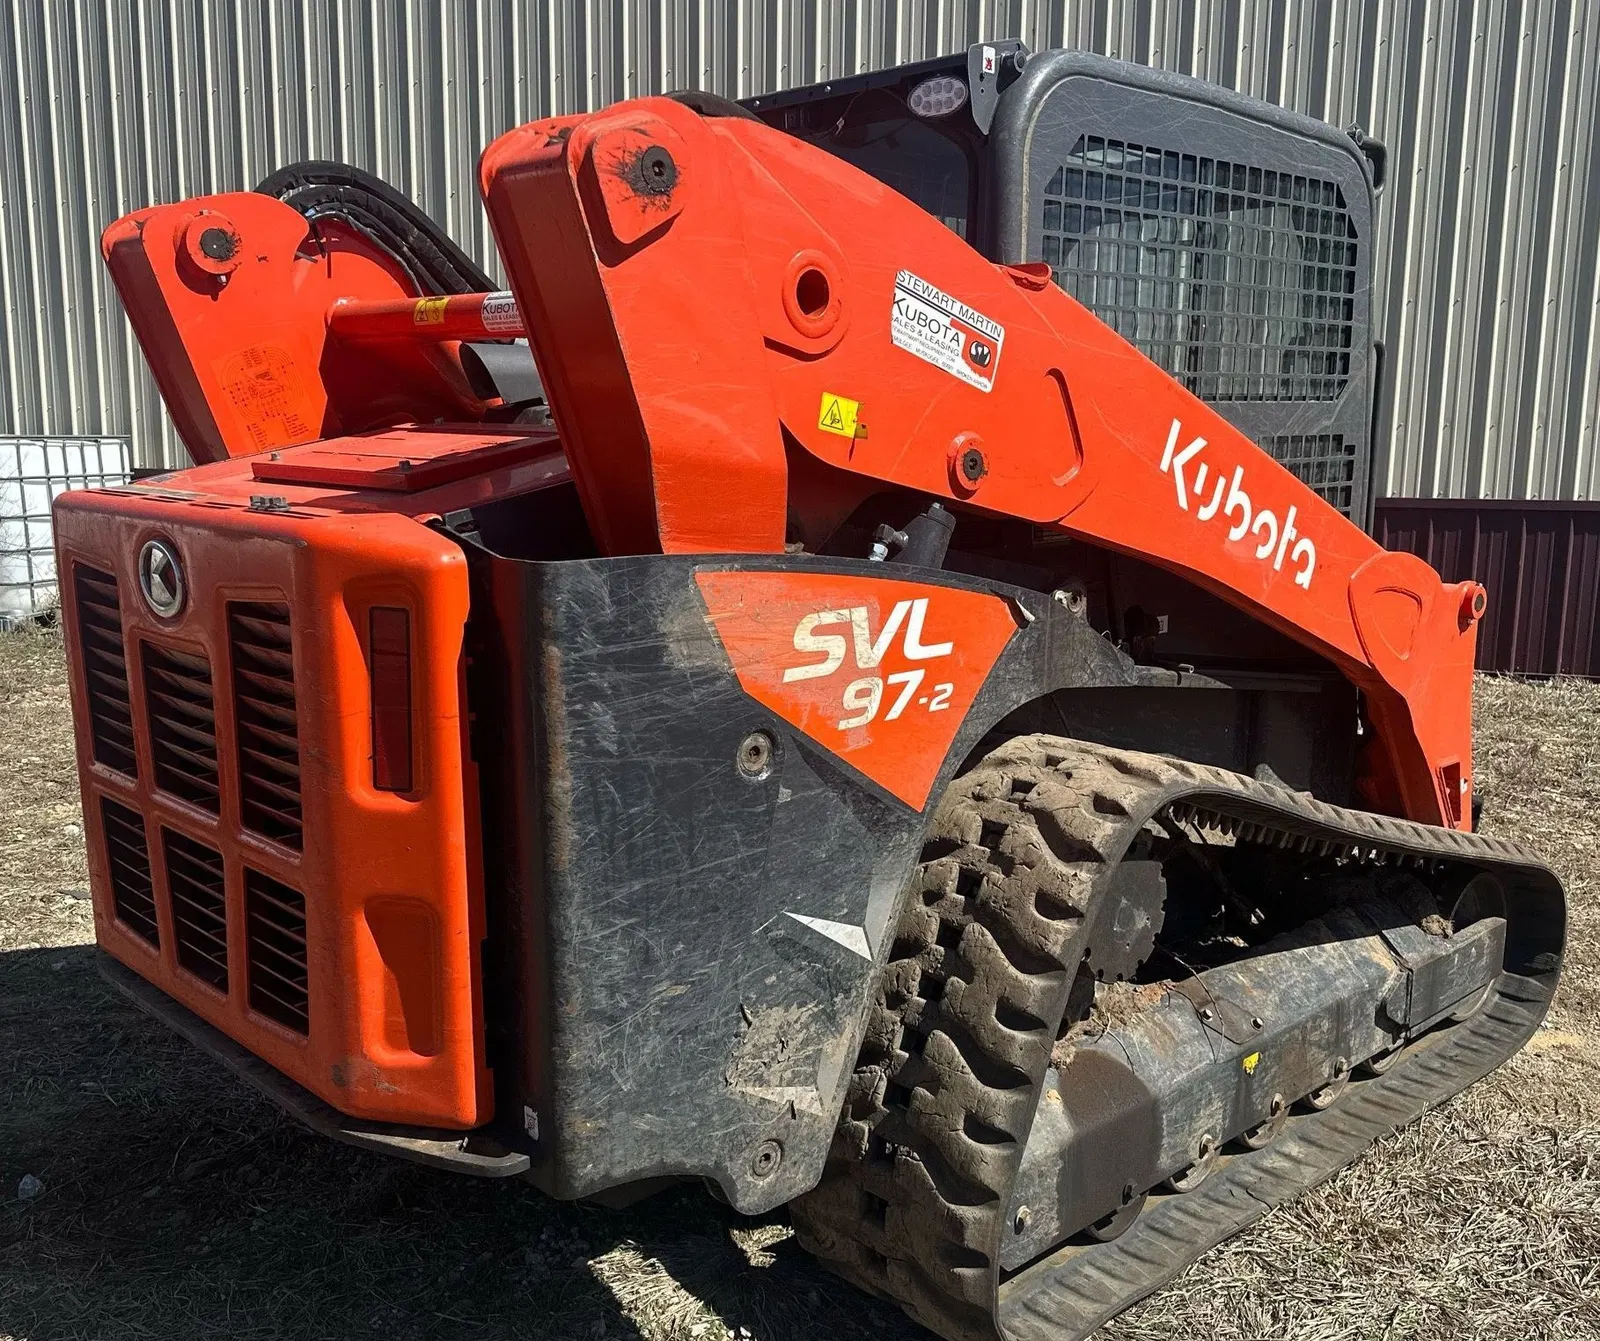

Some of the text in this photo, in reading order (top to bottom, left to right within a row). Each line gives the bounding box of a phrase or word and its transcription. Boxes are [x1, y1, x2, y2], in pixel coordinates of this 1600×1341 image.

[892, 293, 960, 347] KUBOTA
[897, 270, 1002, 338] STEWART MARTIN
[924, 333, 960, 357] LEASING
[1160, 418, 1316, 590] Kubota
[782, 598, 953, 683] SVL
[838, 668, 953, 730] 97-2
